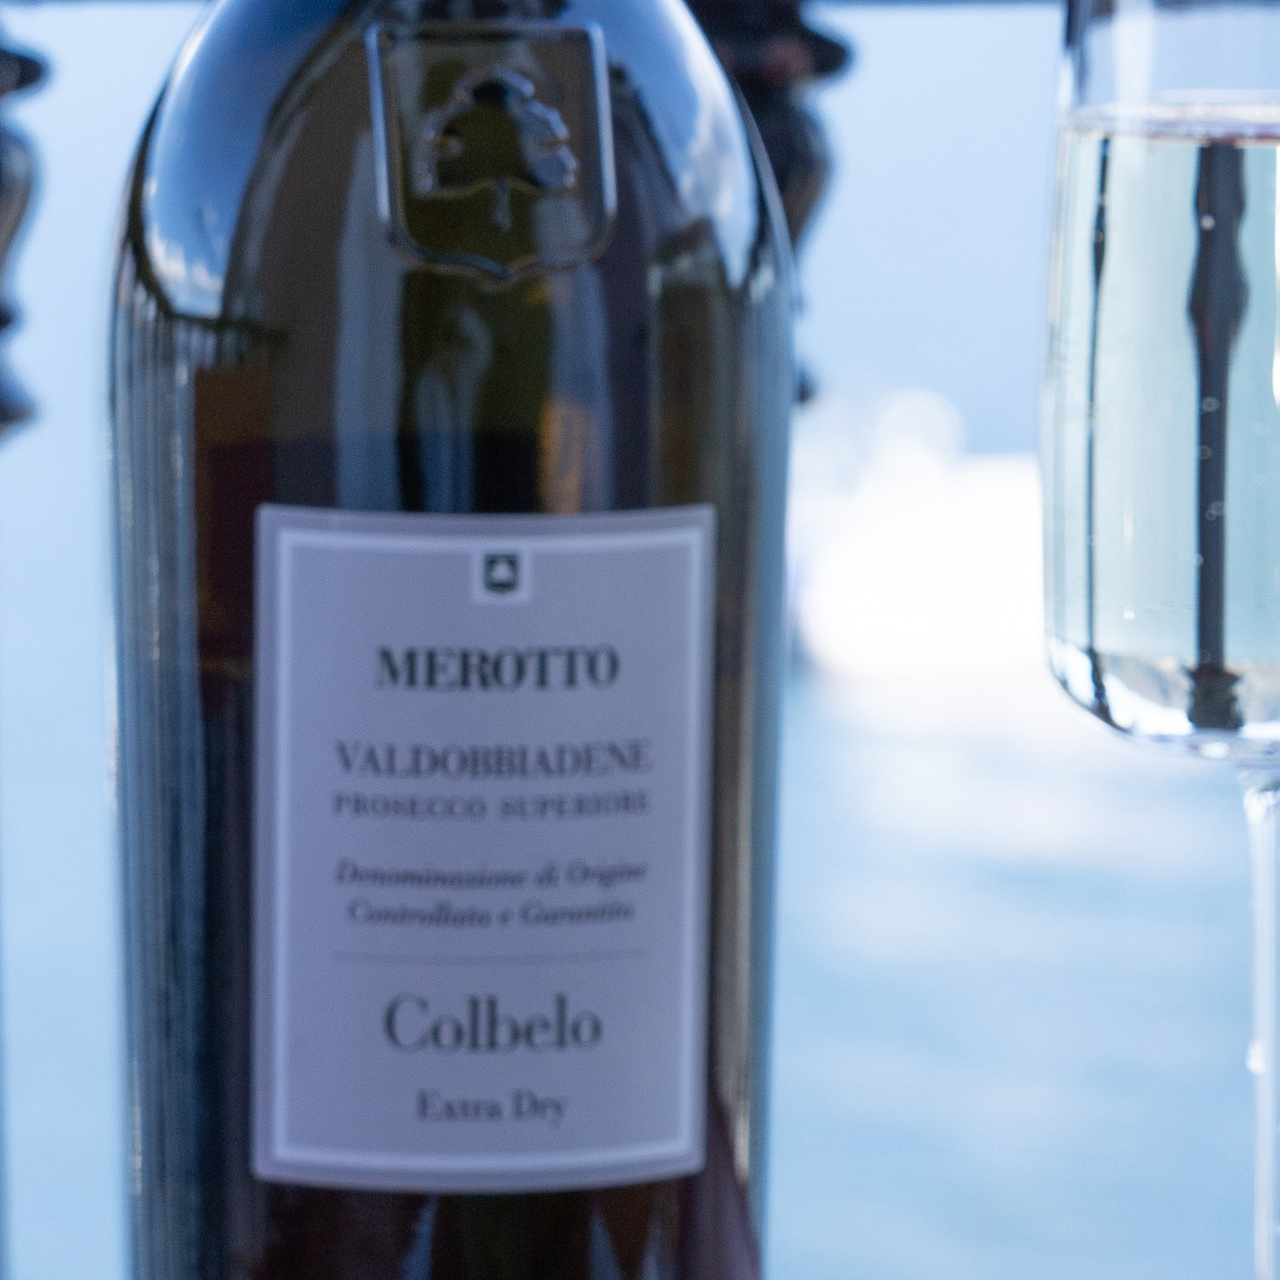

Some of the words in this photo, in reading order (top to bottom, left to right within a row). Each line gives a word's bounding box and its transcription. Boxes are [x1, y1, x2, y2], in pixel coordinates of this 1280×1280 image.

[377, 643, 620, 693] MEROTTO
[334, 736, 652, 781] VALDOBBIADENE
[333, 790, 488, 820] PROSECCO
[501, 788, 649, 819] SUPERIORE
[534, 858, 560, 888] di
[381, 990, 604, 1054] Colbelo
[416, 1087, 504, 1121] Extra
[511, 1087, 568, 1130] Dry
